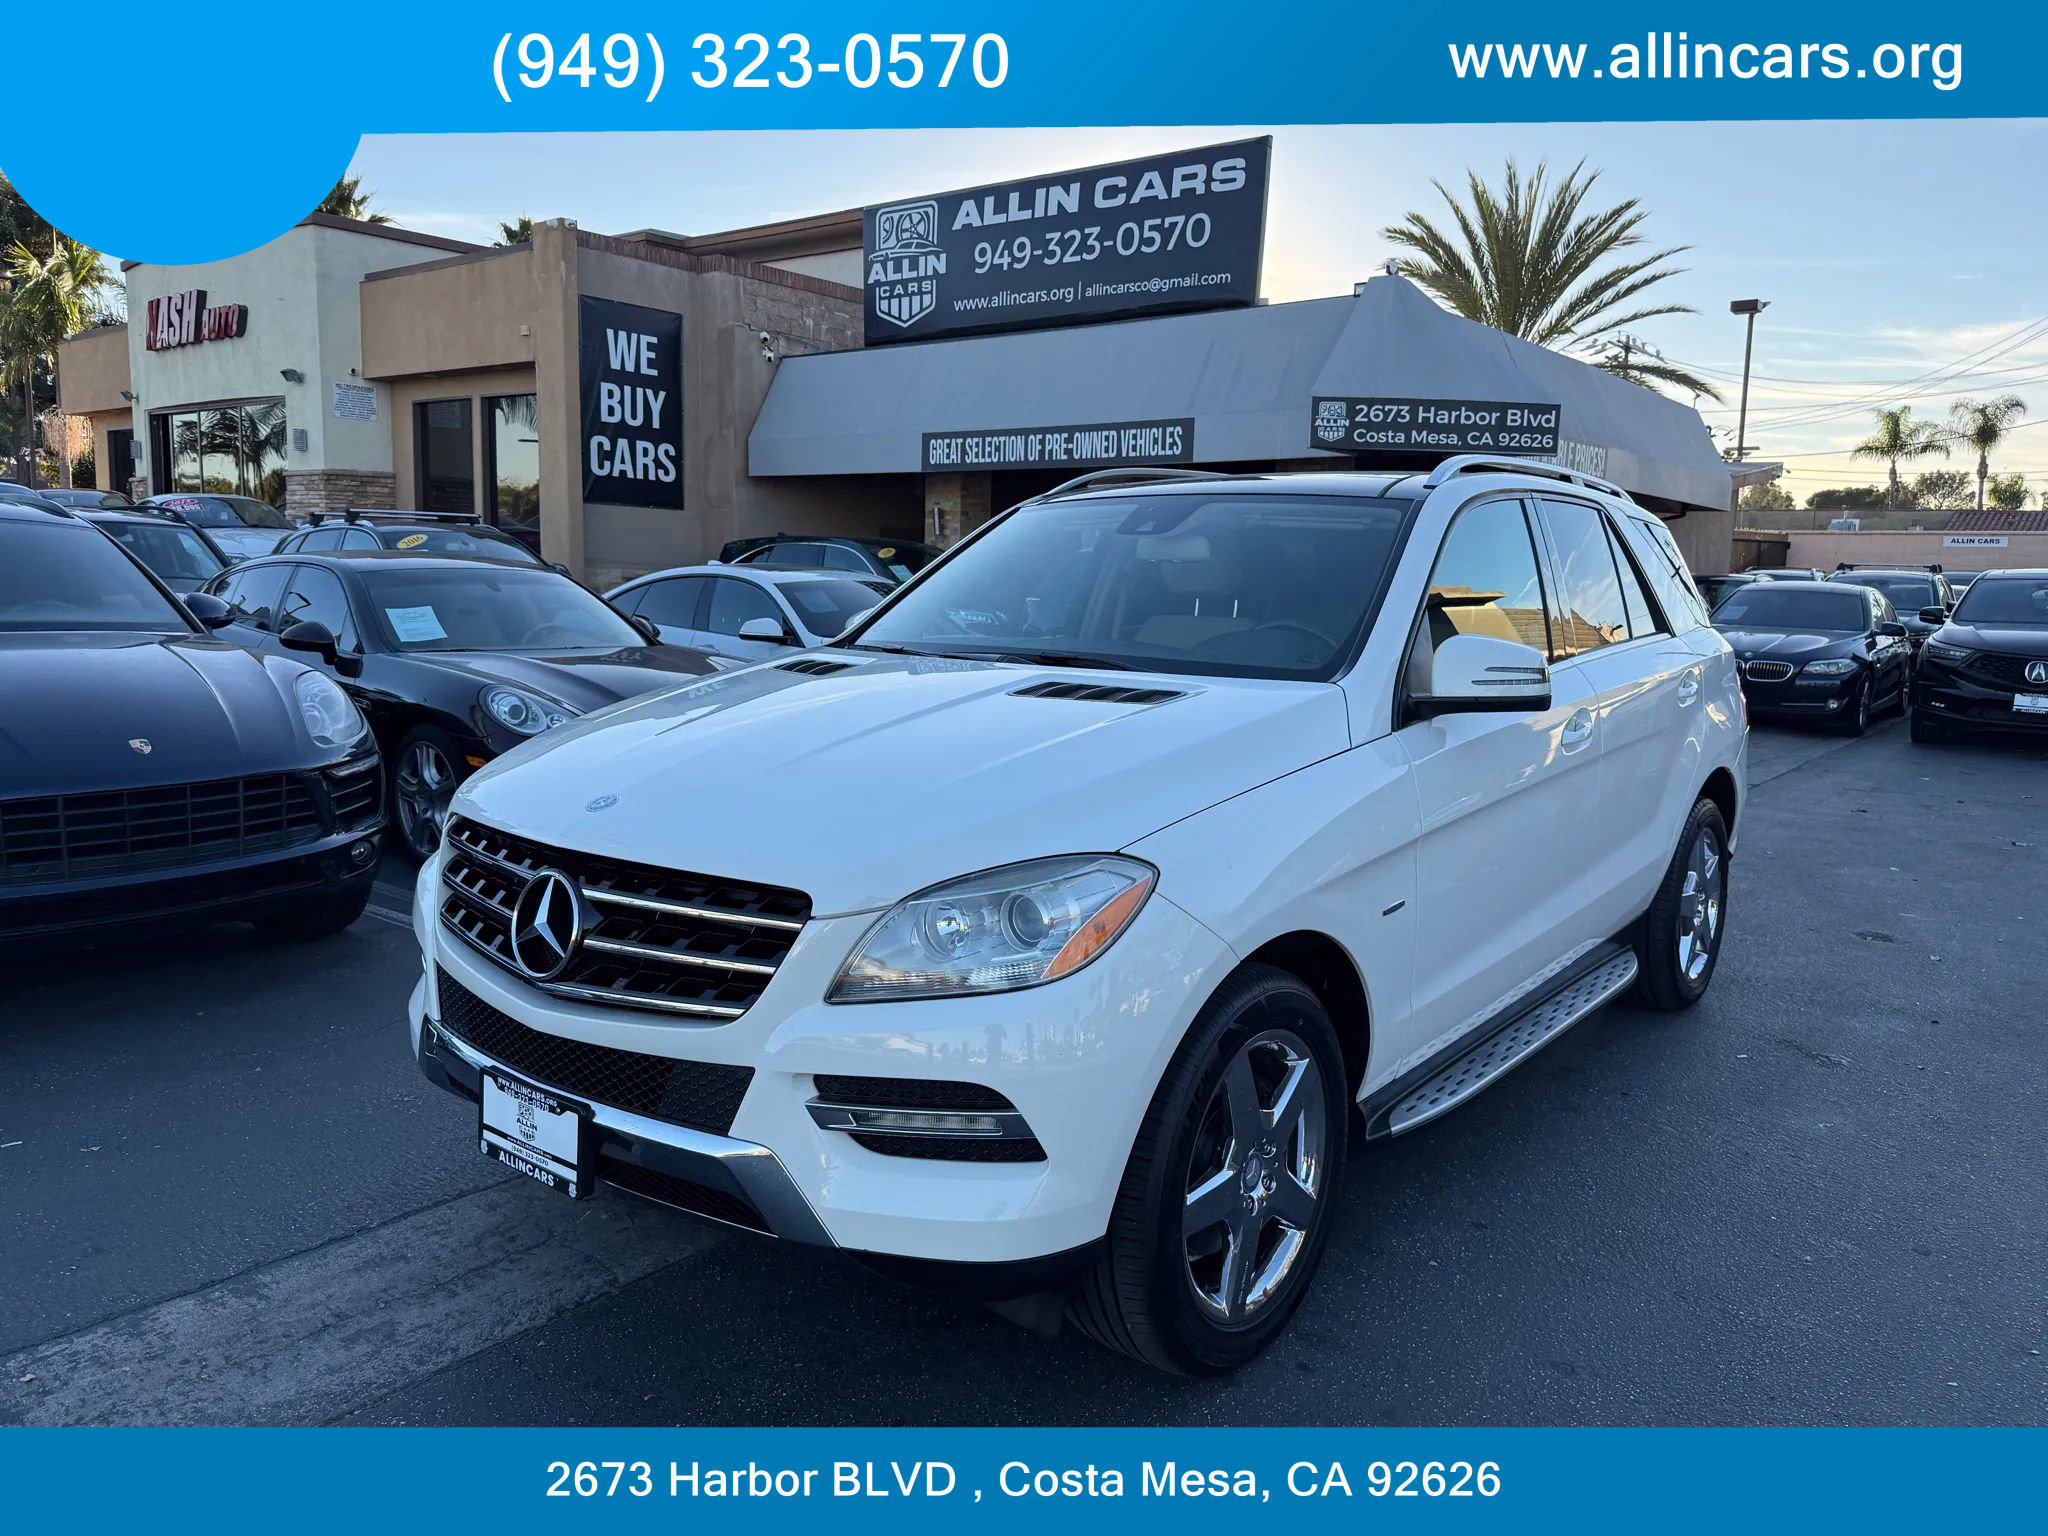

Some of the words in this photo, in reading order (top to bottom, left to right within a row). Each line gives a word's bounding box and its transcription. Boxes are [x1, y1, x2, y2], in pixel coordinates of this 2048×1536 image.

[952, 182, 1080, 230] ALLIN
[1093, 157, 1246, 208] CARS
[974, 212, 1211, 274] 949-323-0570
[867, 253, 946, 284] ALLIN
[880, 280, 931, 297] CARS
[953, 285, 1074, 312] www.allincars.org
[1085, 272, 1231, 298] allincarsco@gmail.com
[146, 289, 205, 351] NASH
[202, 303, 245, 341] AUTO
[606, 328, 658, 376] WE
[600, 381, 666, 429] BUY
[1315, 418, 1350, 426] ALLIN
[1354, 404, 1410, 423] 2673
[1418, 406, 1500, 426] Harbor
[1506, 408, 1556, 428] Blvd
[929, 438, 964, 465] GREAT
[965, 435, 1025, 464] SELECTION
[1027, 434, 1042, 461] OF
[1045, 430, 1117, 460] PRE-OWNED
[1120, 426, 1183, 458] VEHICLES
[1353, 428, 1405, 444] Costa
[1411, 430, 1462, 446] Mesa,
[1467, 432, 1494, 446] CA
[1498, 433, 1554, 448] 92626
[590, 435, 677, 483] CARS
[516, 1116, 538, 1132] ALLIN
[498, 1150, 555, 1187] ALLINCARS
